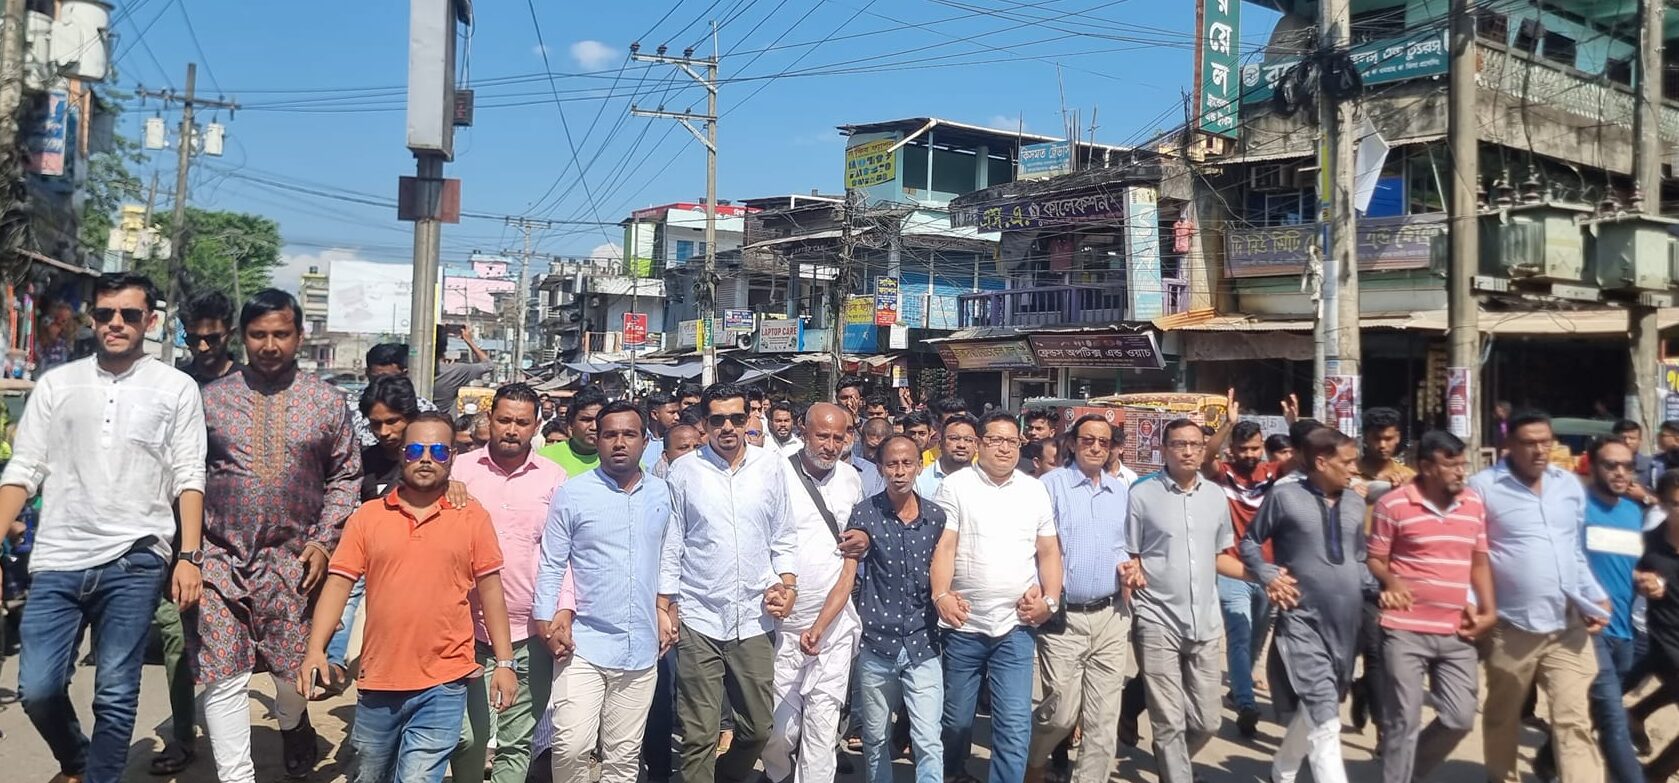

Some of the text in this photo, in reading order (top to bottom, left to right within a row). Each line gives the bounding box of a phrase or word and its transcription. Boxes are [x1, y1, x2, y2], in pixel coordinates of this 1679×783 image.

[1041, 194, 1110, 217] কালেকশন
[761, 326, 797, 337] LAPTOP CARE
